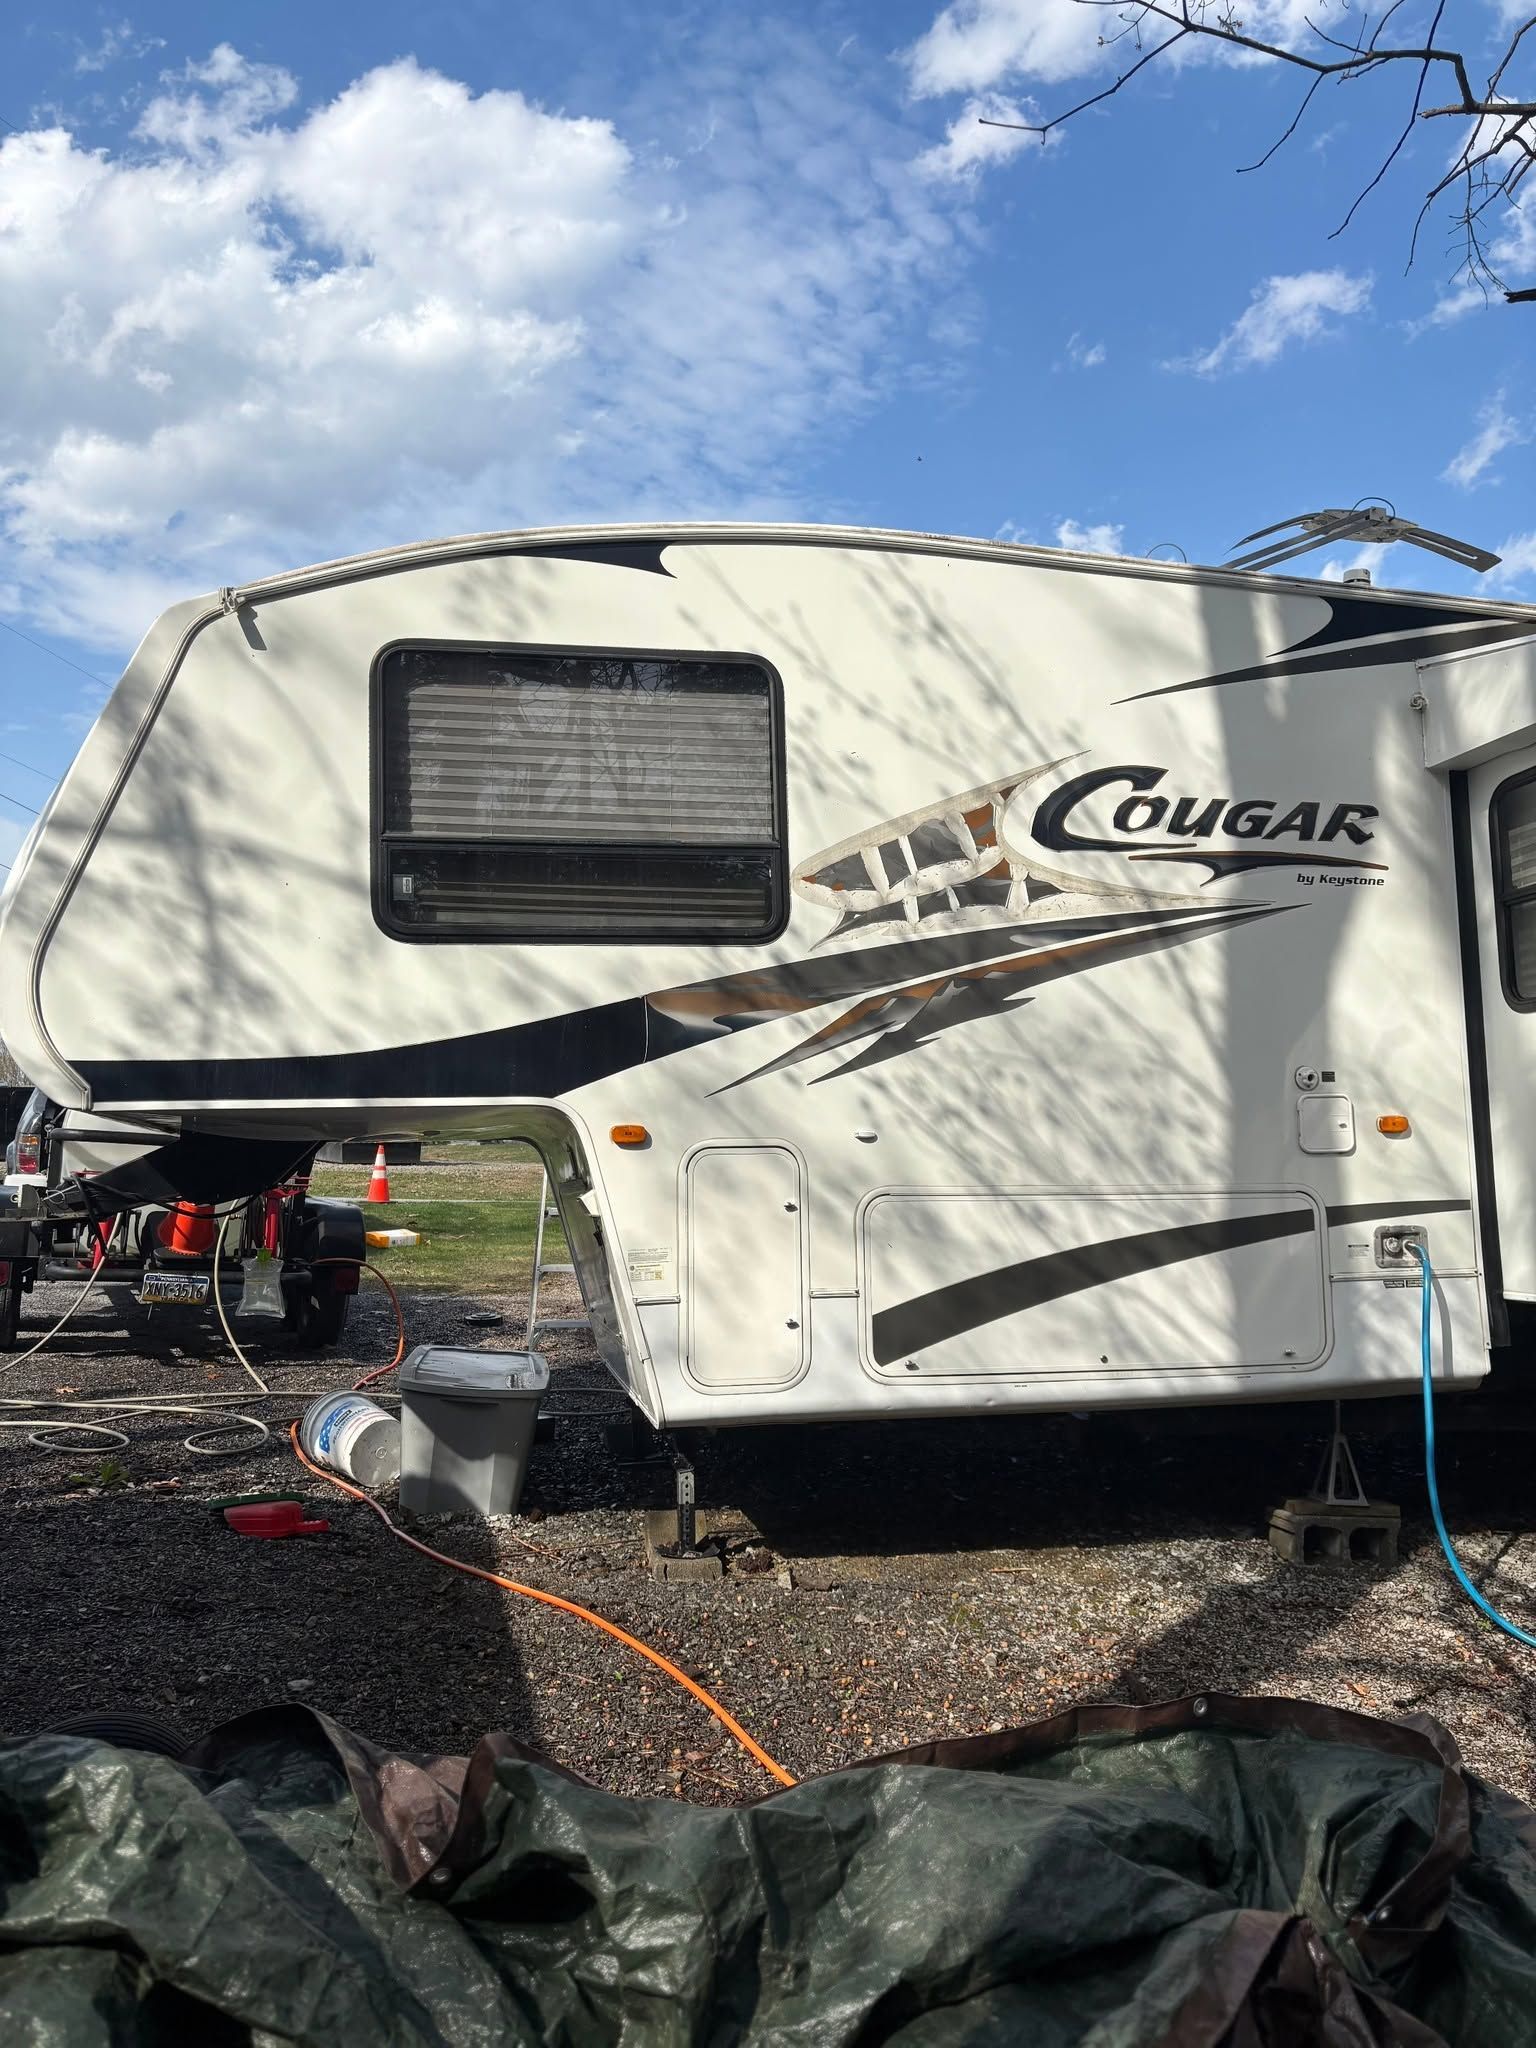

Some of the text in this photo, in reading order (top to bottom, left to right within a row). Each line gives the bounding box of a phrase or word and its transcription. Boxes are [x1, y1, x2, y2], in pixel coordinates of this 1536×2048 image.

[1030, 764, 1380, 852] COUGAR
[1297, 873, 1385, 887] by Keystone
